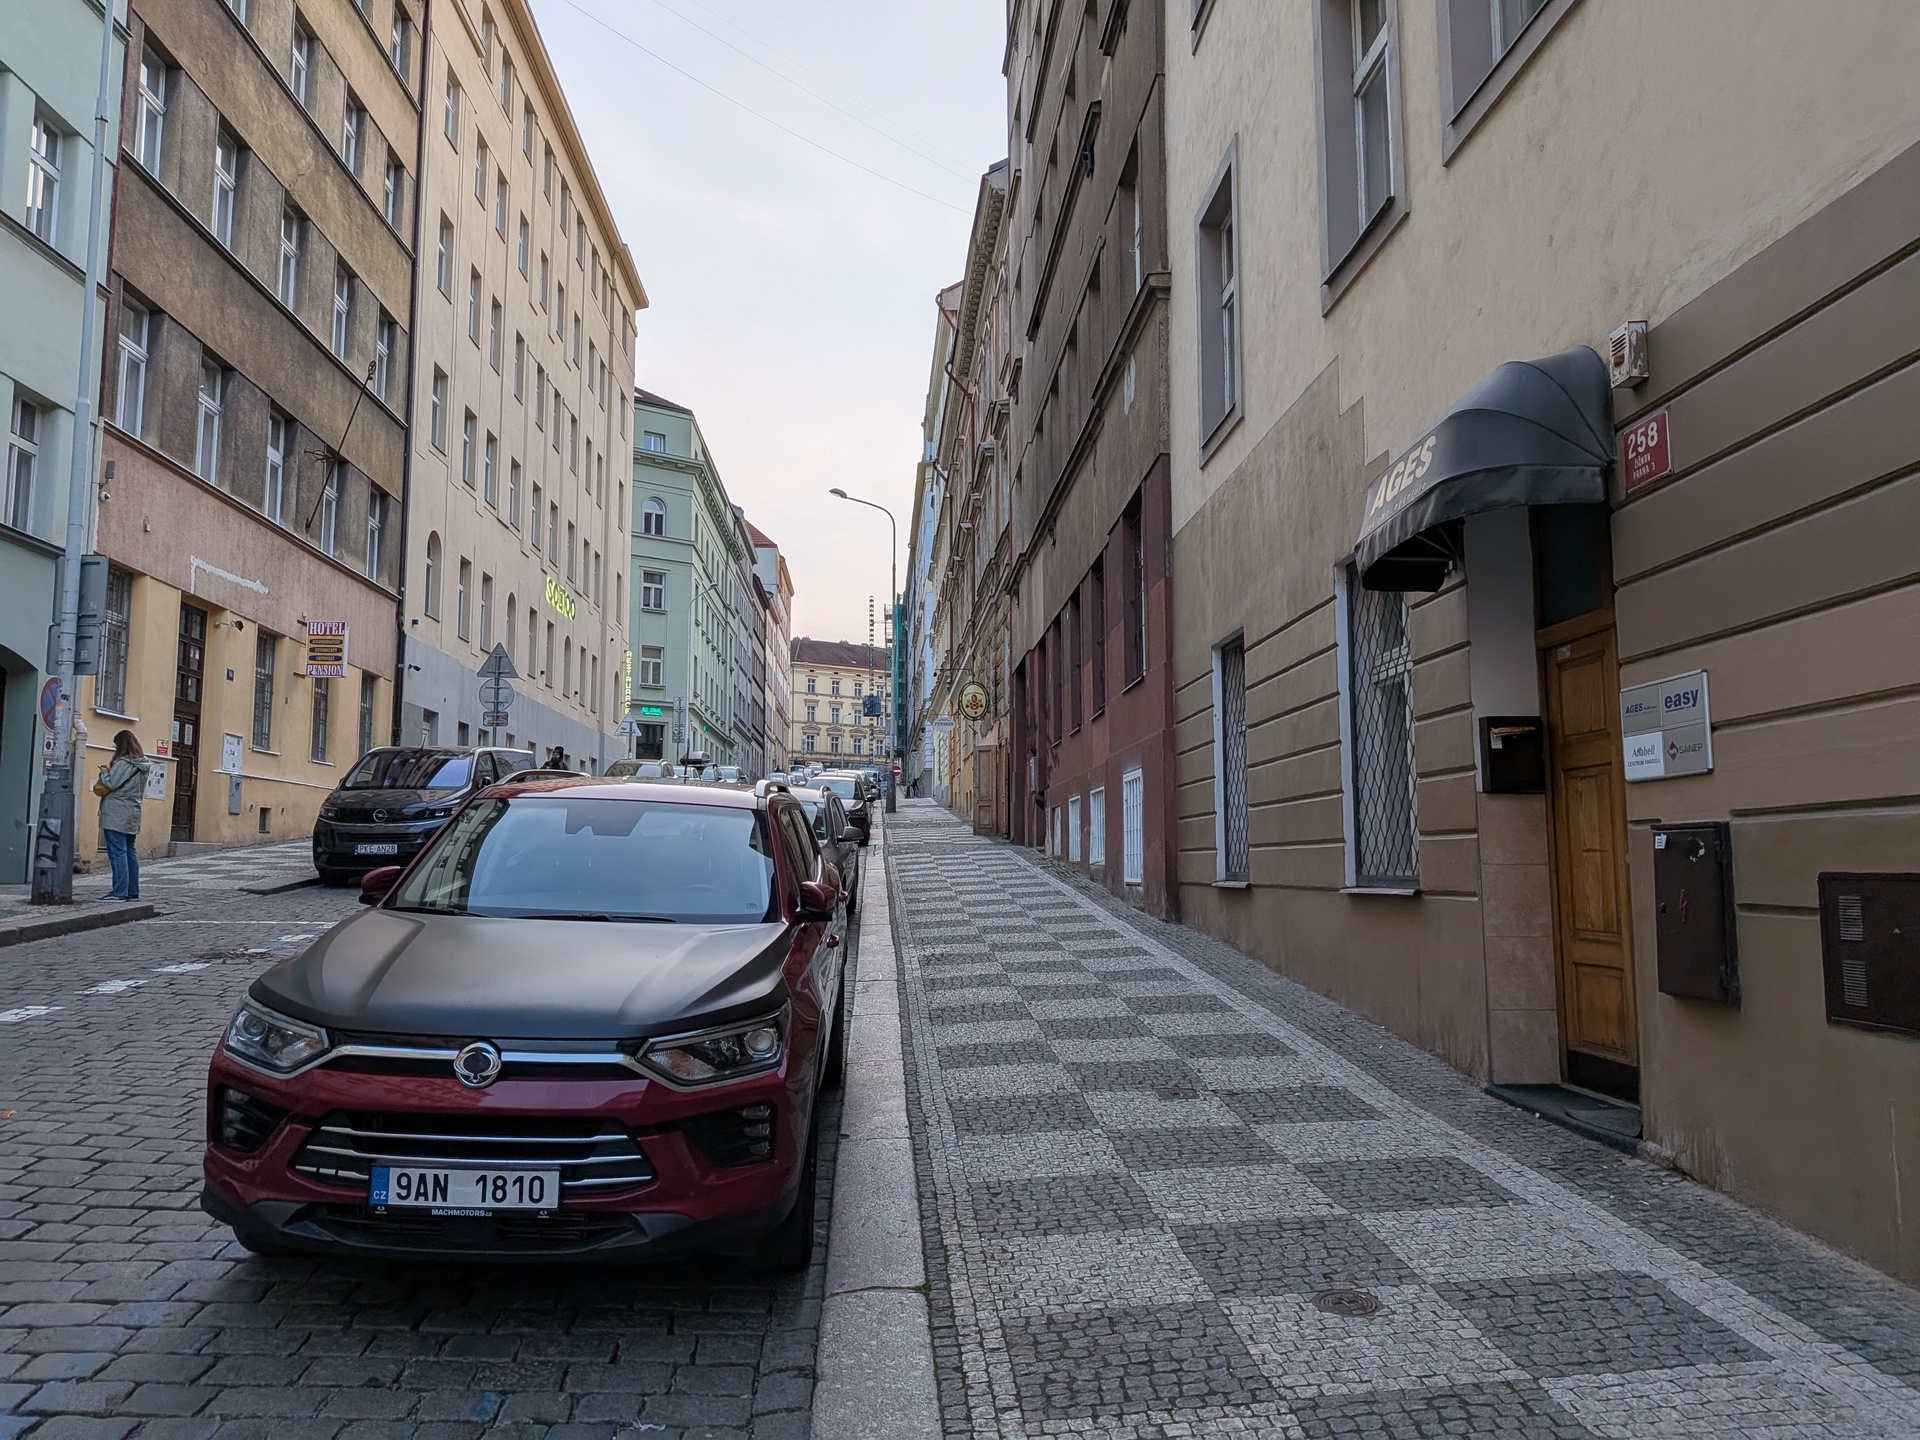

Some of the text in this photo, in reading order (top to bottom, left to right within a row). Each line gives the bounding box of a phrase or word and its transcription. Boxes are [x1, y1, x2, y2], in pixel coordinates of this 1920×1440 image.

[1627, 421, 1658, 460] 258
[1651, 461, 1656, 471] 3
[1370, 435, 1437, 517] AGES
[309, 622, 345, 635] HOTEL
[307, 664, 343, 676] PENSION
[1664, 689, 1699, 709] easy
[1625, 703, 1643, 715] AGES
[1632, 744, 1656, 758] Anabell
[1679, 743, 1703, 754] SANEP
[396, 1172, 544, 1204] 9AN 1810
[373, 1190, 386, 1200] CZ
[431, 1209, 493, 1217] MACHMOTORS.cz
